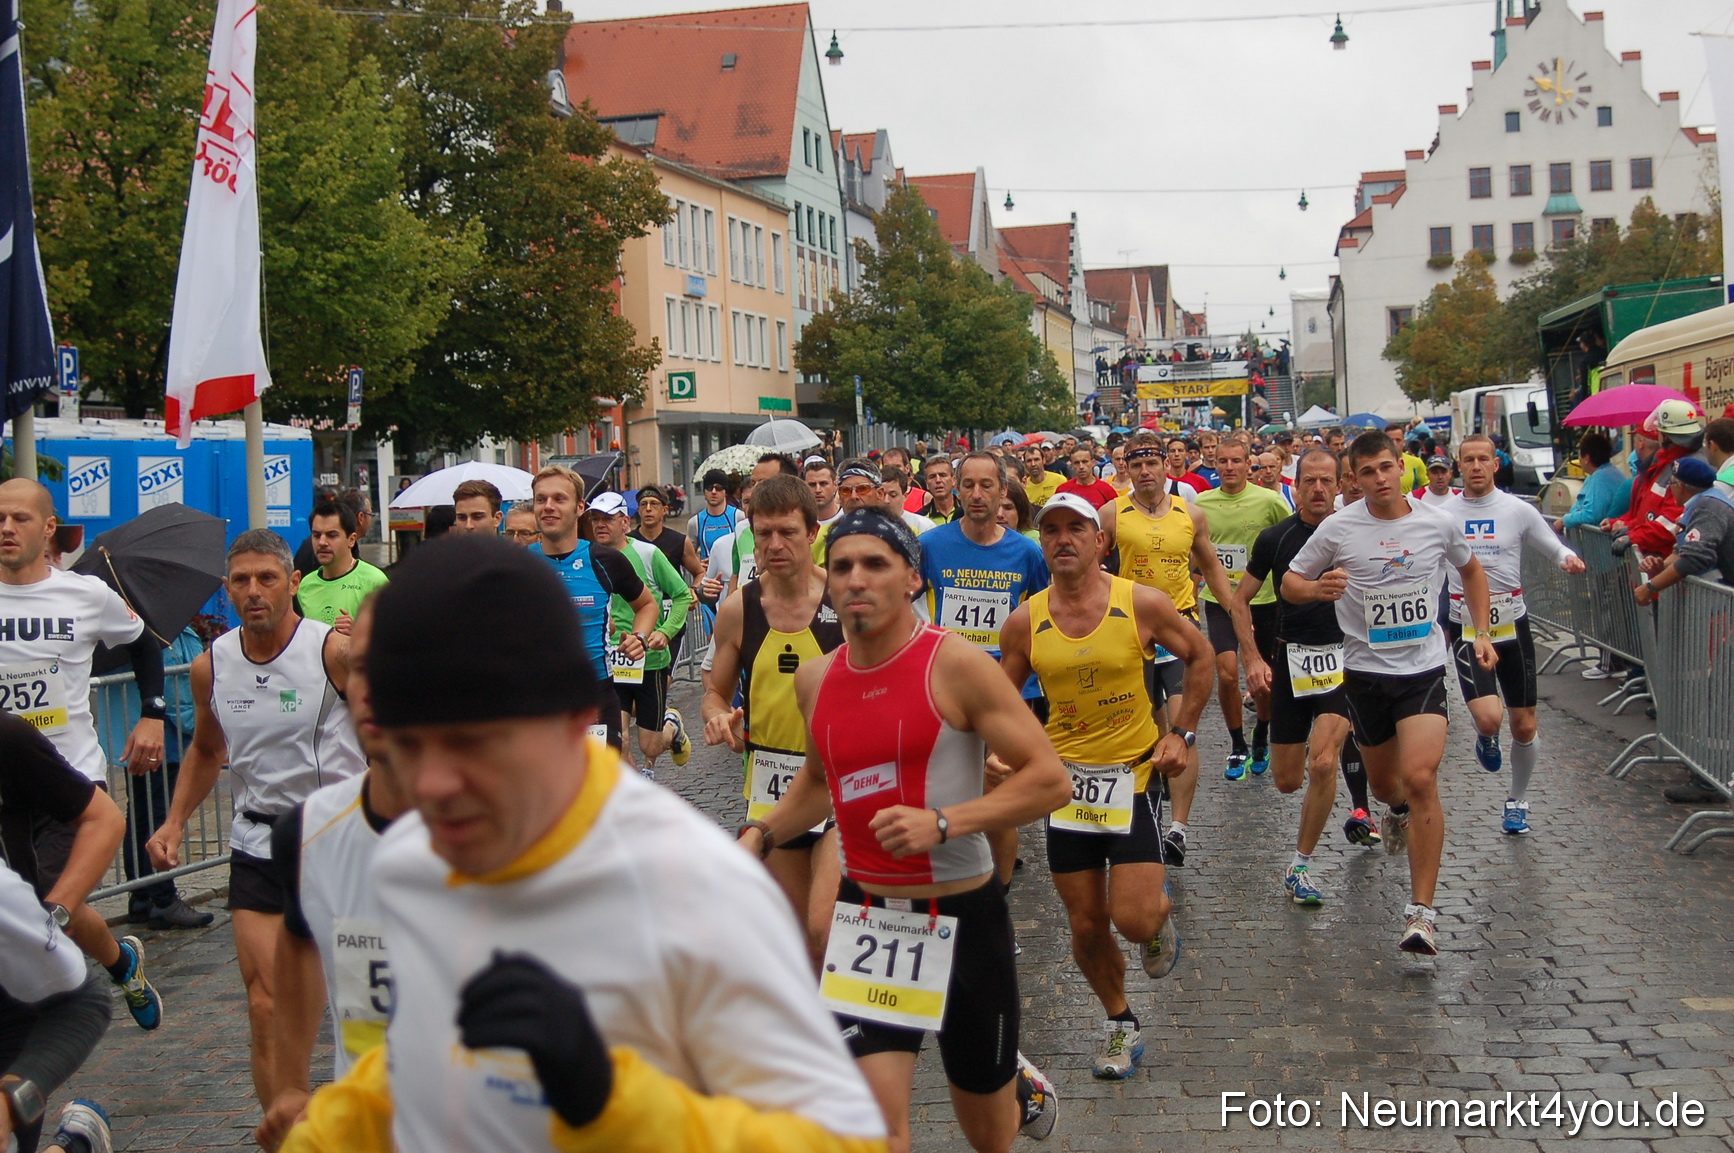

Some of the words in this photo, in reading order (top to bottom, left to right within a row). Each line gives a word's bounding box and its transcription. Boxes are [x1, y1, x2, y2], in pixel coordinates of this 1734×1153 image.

[62, 353, 74, 386] P
[672, 376, 691, 395] D
[1173, 385, 1211, 395] START
[941, 569, 955, 578] 10.
[957, 569, 1022, 582] NEUMARKTER
[954, 578, 1011, 590] STADTLAUF
[944, 593, 966, 601] PARTL
[968, 596, 999, 604] Neumarkt
[1389, 590, 1419, 599] Neumarkt
[955, 605, 996, 628] 414
[1372, 598, 1428, 625] 2166
[957, 631, 990, 643] ichael
[1387, 629, 1417, 640] Fabian
[1302, 653, 1337, 674] 400
[7, 669, 47, 680] Neumarkt
[1312, 677, 1333, 686] Frank
[0, 680, 49, 711] 252
[281, 701, 296, 712] KP
[1058, 704, 1077, 714] Seidl
[755, 759, 778, 769] PARTL
[853, 773, 880, 791] DEHN
[1072, 774, 1117, 804] 367
[1075, 809, 1107, 823] Robert
[836, 912, 875, 929] PARTL
[879, 920, 933, 936] Neumarkt
[337, 934, 387, 950] PARTL
[851, 934, 924, 981] 211
[867, 988, 897, 1007] Udo
